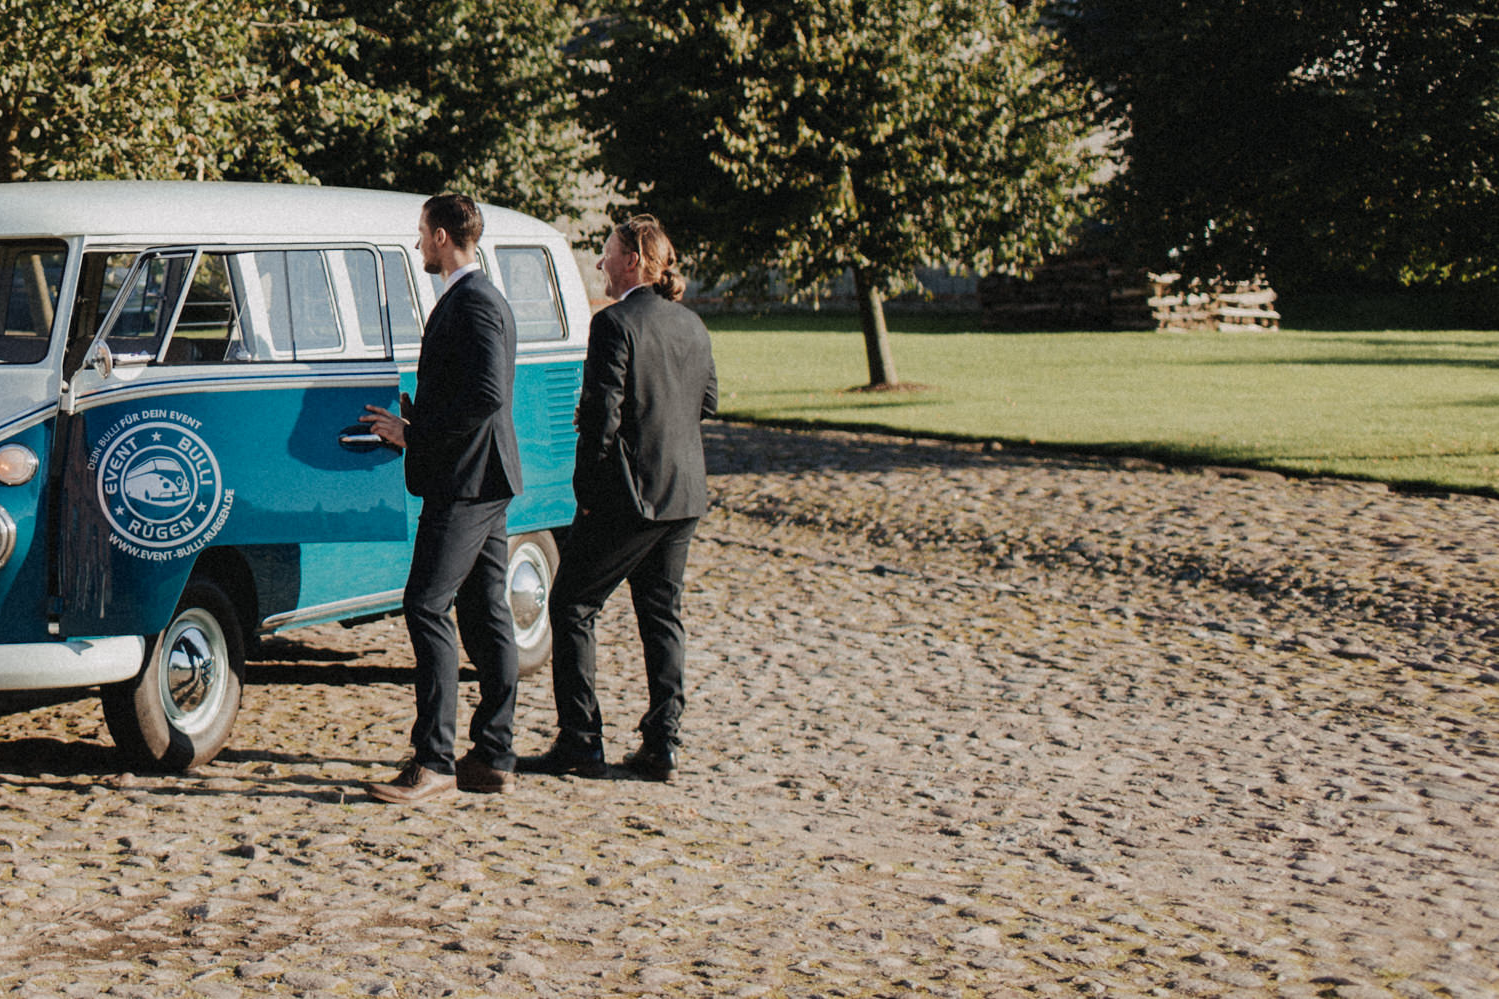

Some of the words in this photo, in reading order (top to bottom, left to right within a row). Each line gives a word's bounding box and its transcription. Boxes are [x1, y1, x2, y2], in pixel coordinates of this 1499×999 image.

[87, 447, 102, 471] DEIN
[98, 423, 120, 448] BULLI
[120, 412, 141, 429] FÜR
[142, 409, 167, 419] DEIN
[169, 410, 202, 430] EVENT
[104, 436, 139, 495] EVENT
[177, 436, 213, 486] BULLI
[109, 488, 235, 562] WWW.EVENT-BULLI-RUEGEN.DE
[127, 516, 195, 540] RÜGEN
